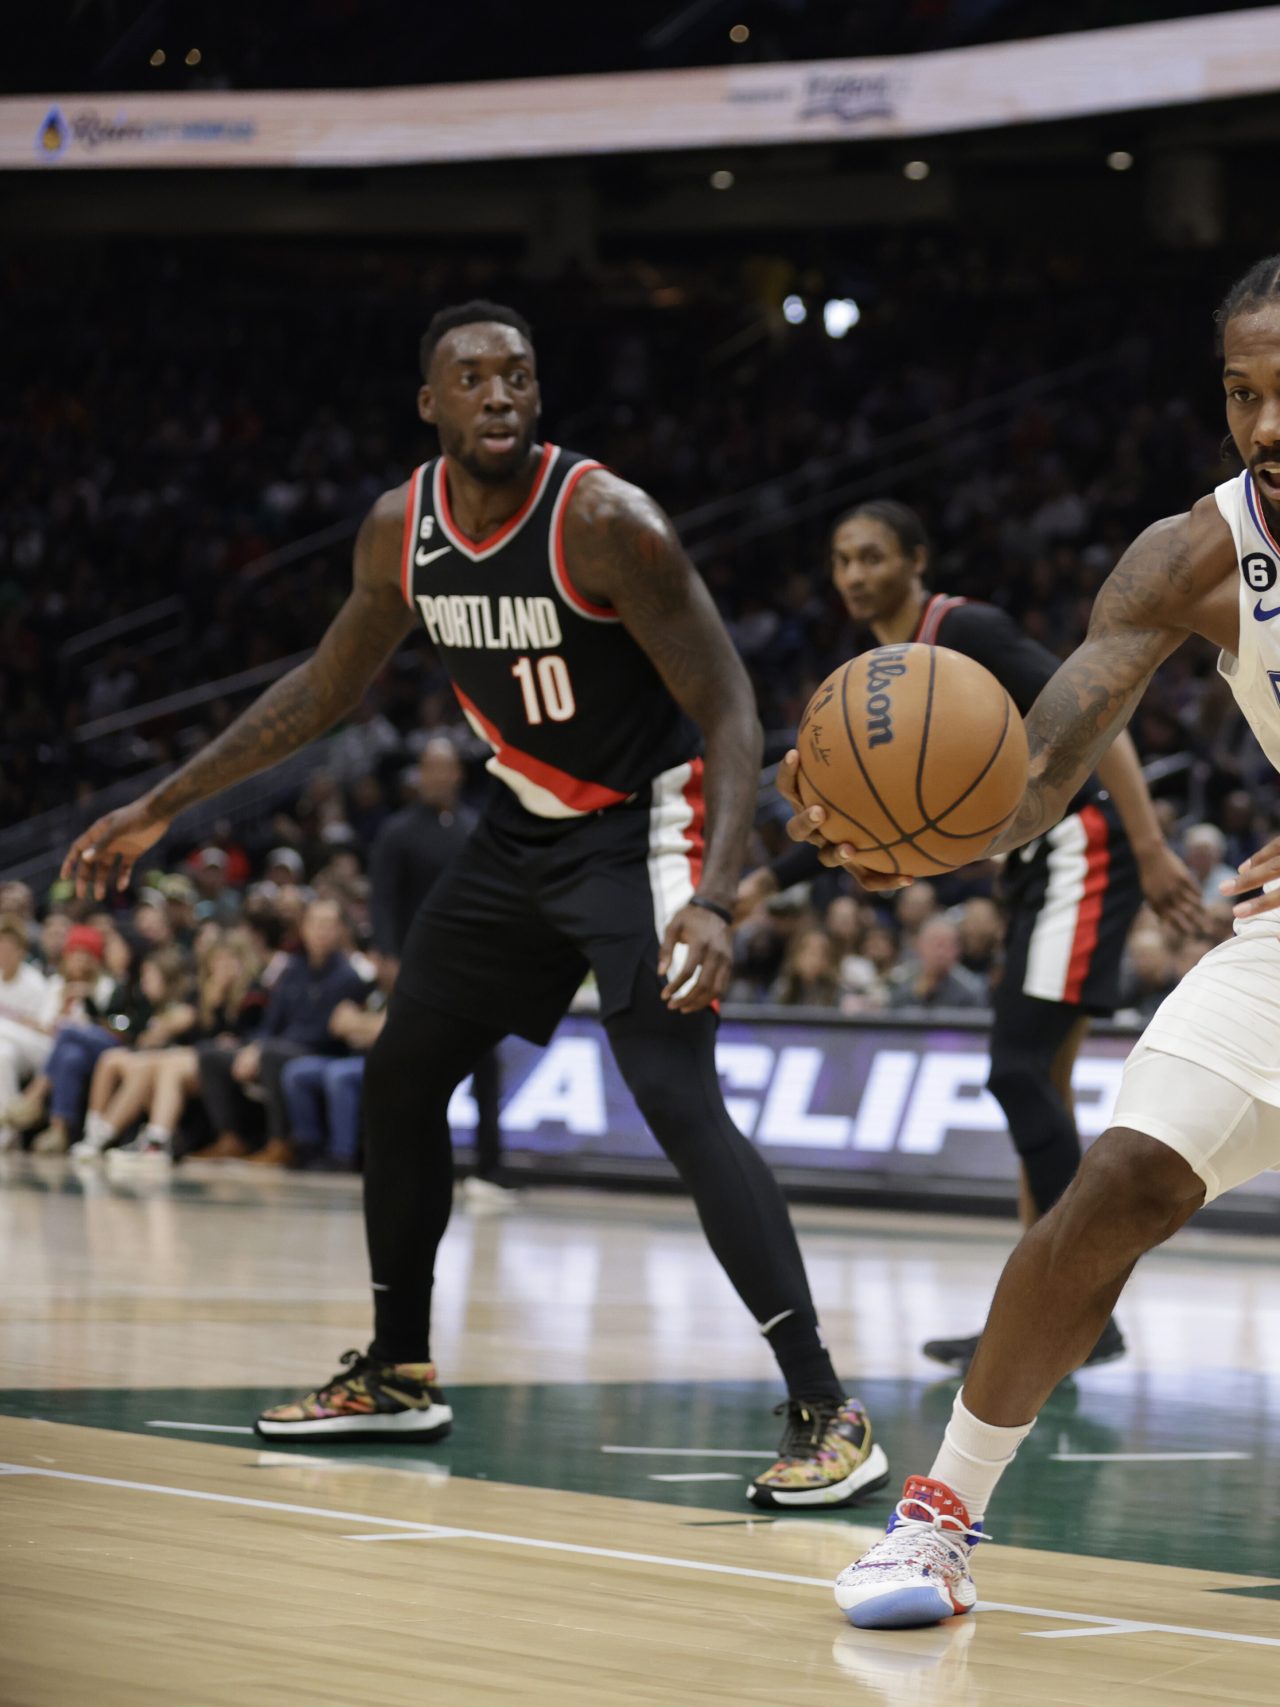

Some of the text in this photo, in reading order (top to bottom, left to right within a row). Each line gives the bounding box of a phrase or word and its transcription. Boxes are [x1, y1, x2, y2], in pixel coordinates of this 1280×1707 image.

[419, 514, 435, 540] 6
[1246, 557, 1271, 588] 6
[415, 594, 563, 650] PORTLAND
[511, 655, 577, 726] 10
